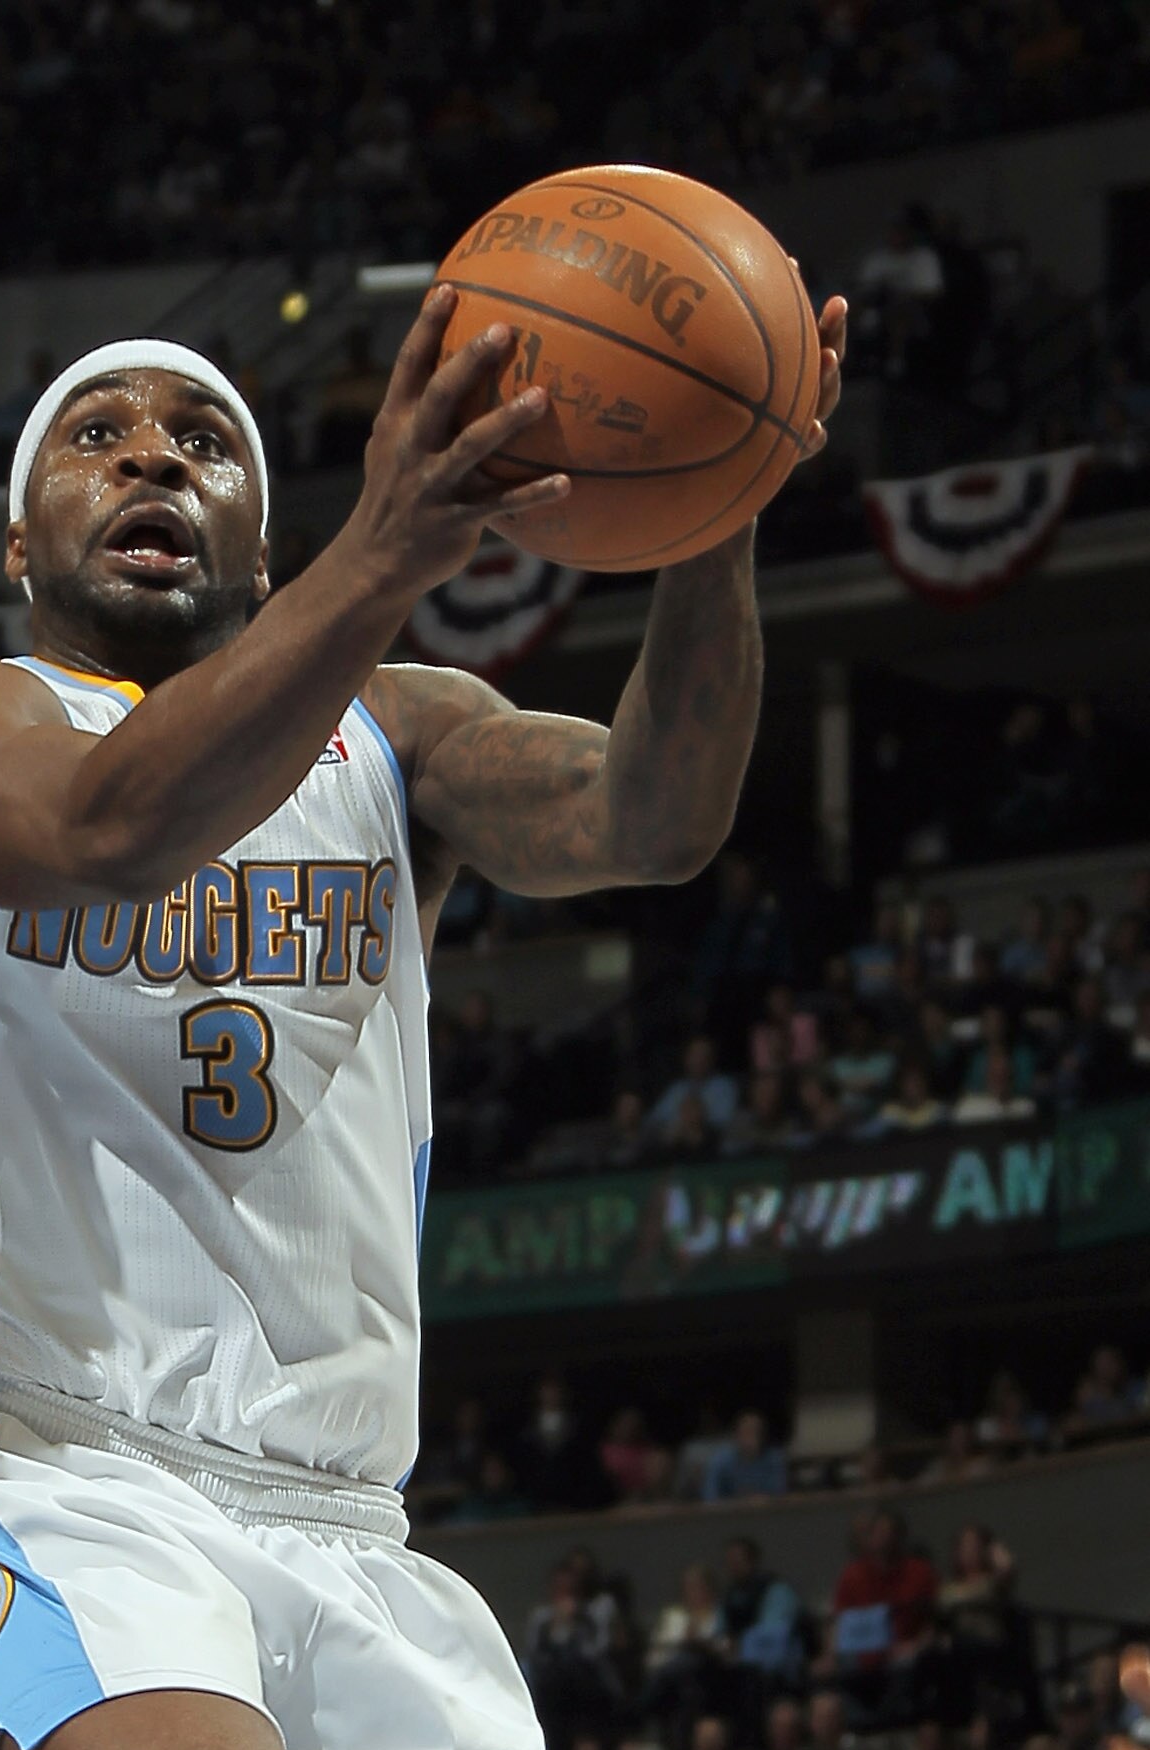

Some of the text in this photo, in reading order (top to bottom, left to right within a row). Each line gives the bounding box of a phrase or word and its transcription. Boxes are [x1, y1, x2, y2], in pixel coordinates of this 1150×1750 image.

[456, 211, 708, 348] SPALDING
[6, 858, 398, 986] NUGGETS
[180, 998, 277, 1153] 3
